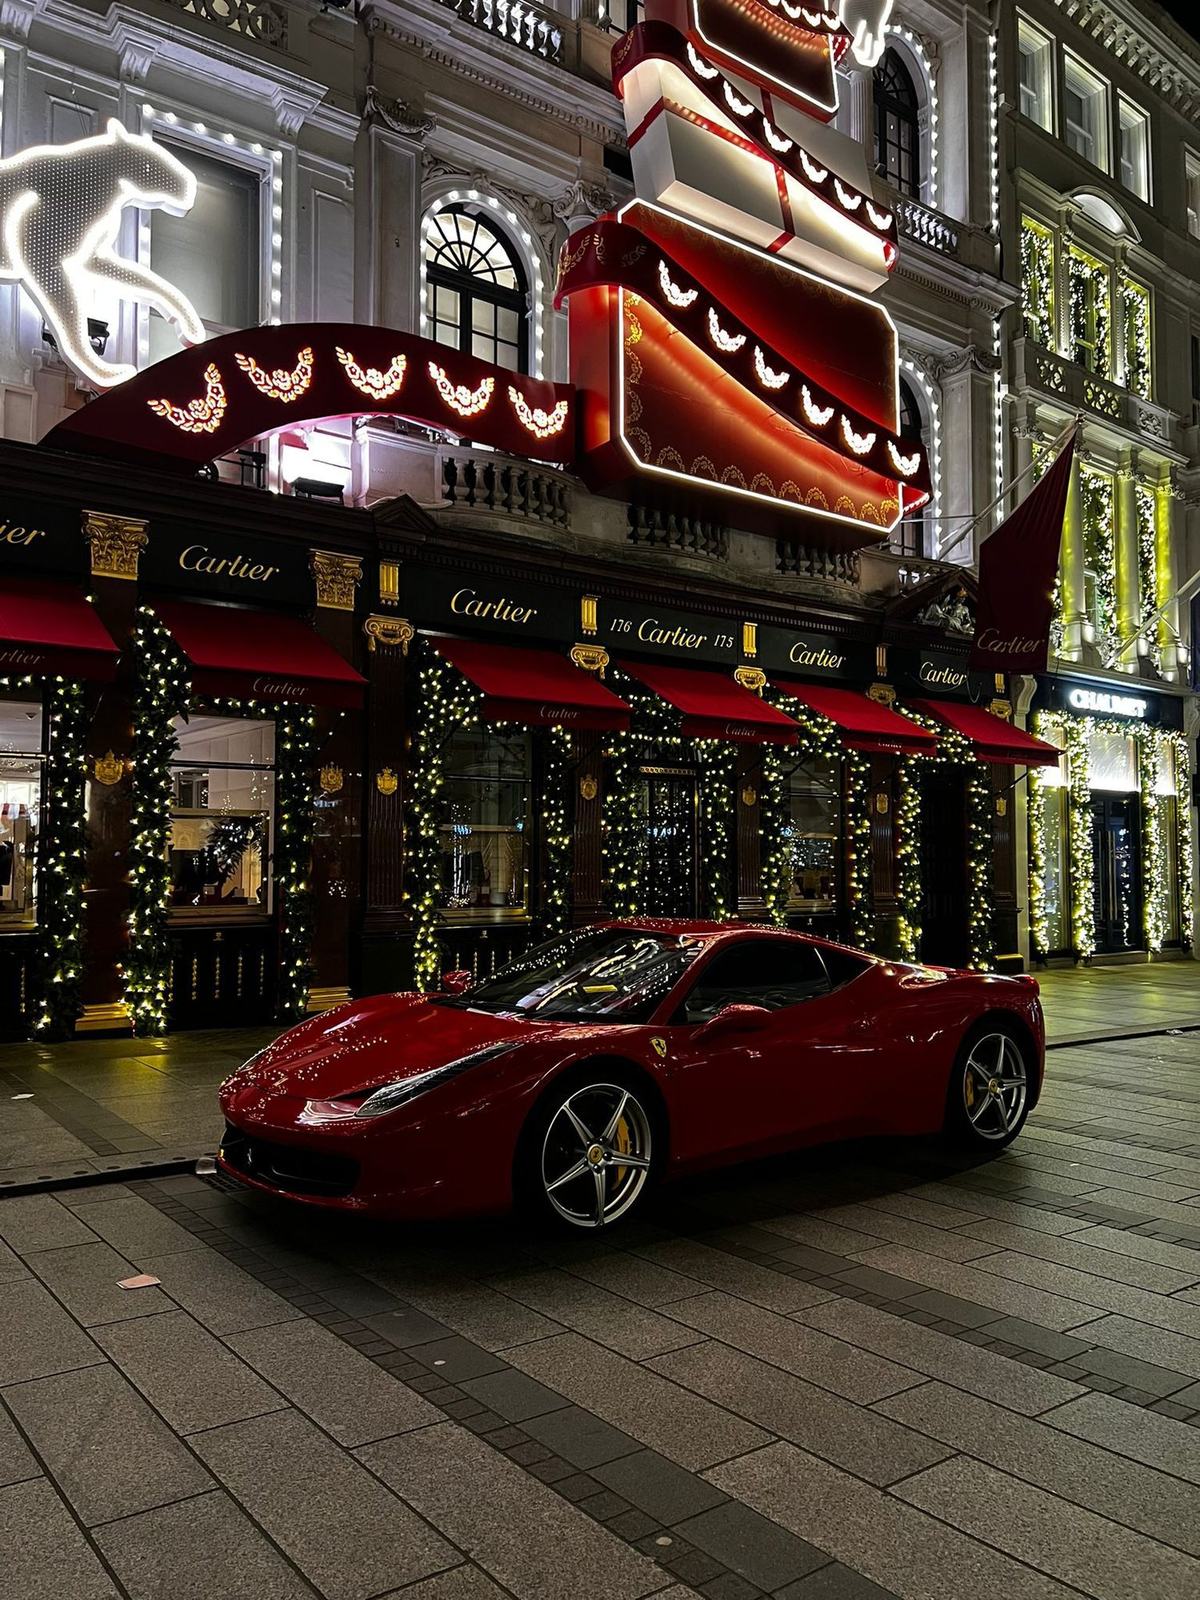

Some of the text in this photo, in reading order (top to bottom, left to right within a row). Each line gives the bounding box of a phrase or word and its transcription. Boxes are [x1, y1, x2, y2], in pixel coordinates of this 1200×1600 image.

[179, 544, 280, 582] Cartier
[450, 588, 538, 624] Cartier
[610, 618, 735, 649] 176 Cartier 175
[977, 627, 1045, 654] Cartier
[789, 641, 847, 669] Cartier
[252, 676, 309, 697] Cartier
[919, 661, 967, 686] Cartier
[539, 703, 581, 720] Cartier
[1069, 688, 1147, 718] CHAUMET
